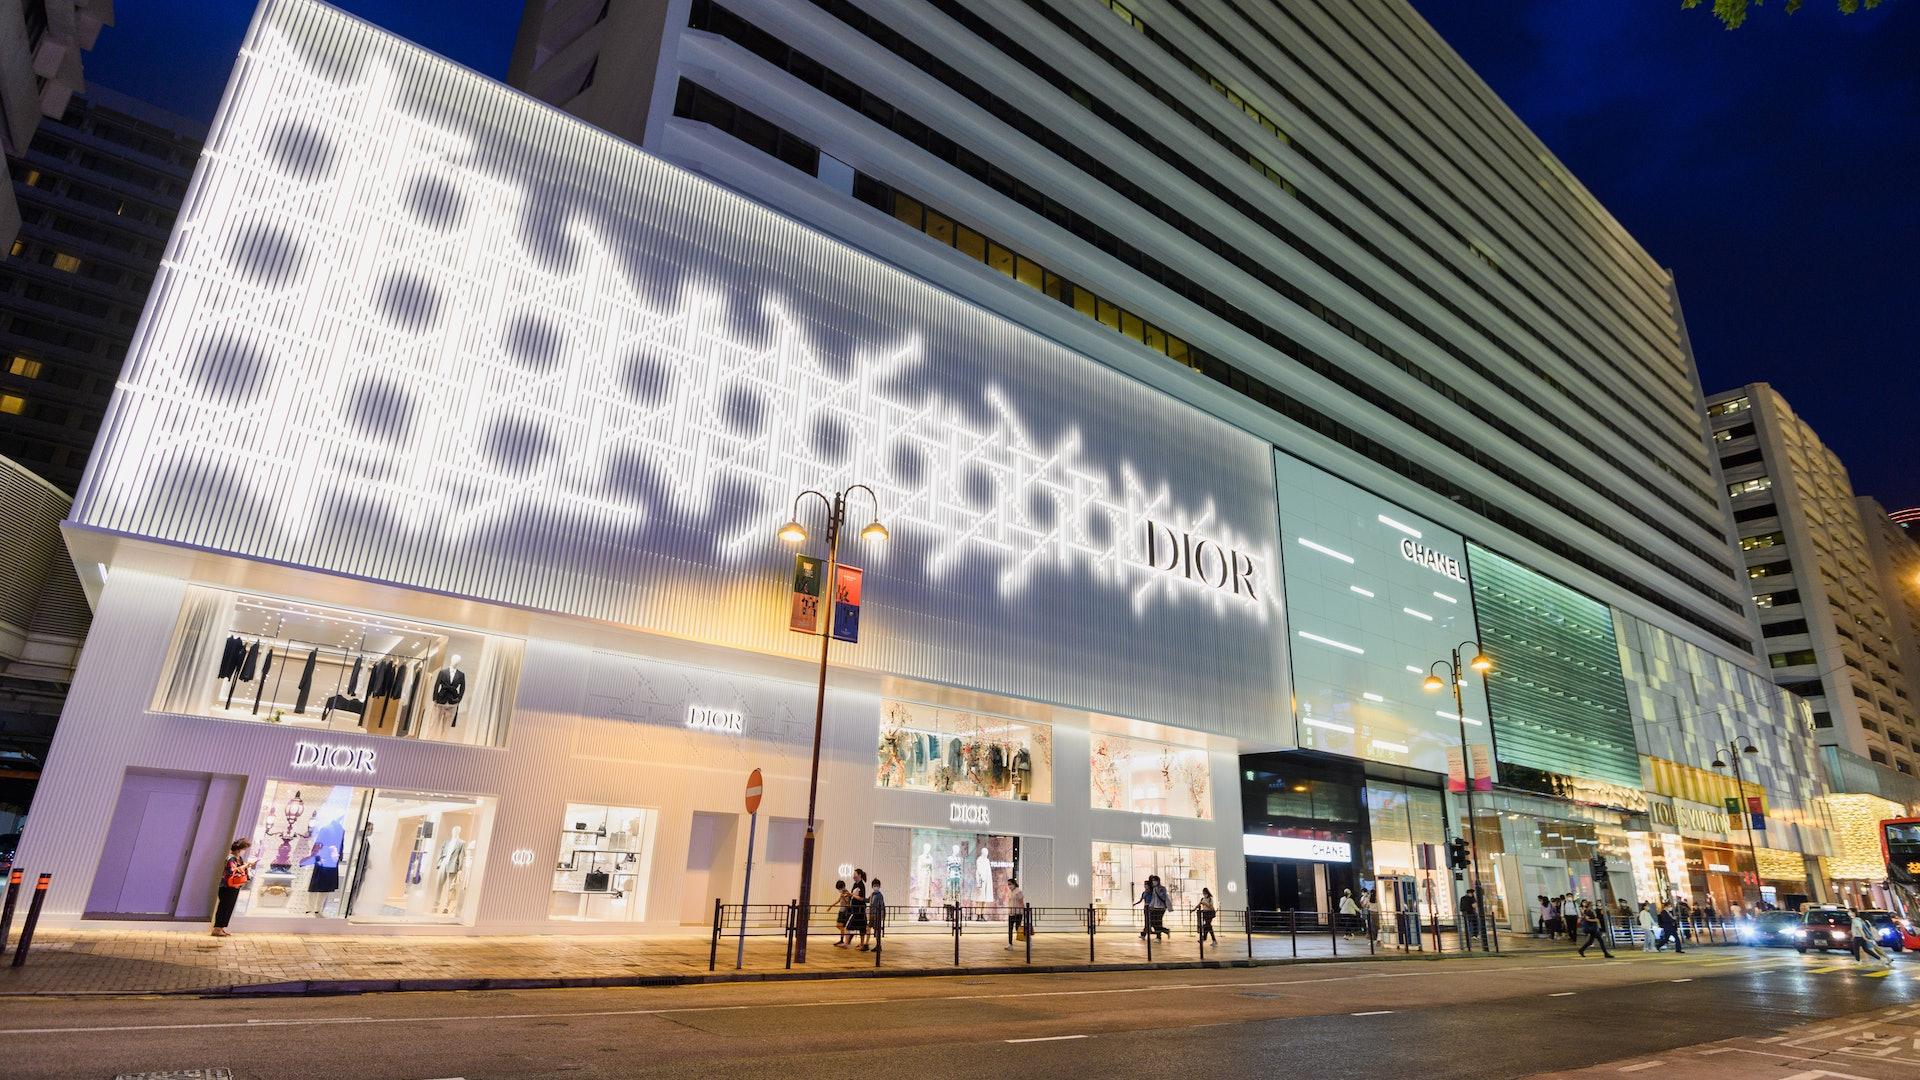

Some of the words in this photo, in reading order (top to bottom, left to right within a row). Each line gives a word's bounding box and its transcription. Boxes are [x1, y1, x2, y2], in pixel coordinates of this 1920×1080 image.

[1146, 518, 1259, 602] DIOR
[1400, 537, 1467, 583] CHANEL
[688, 707, 742, 731] DIOR
[292, 742, 377, 773] DIOR
[950, 803, 990, 825] DIOR
[1140, 821, 1172, 840] DIOR
[1312, 842, 1350, 859] CHANEL
